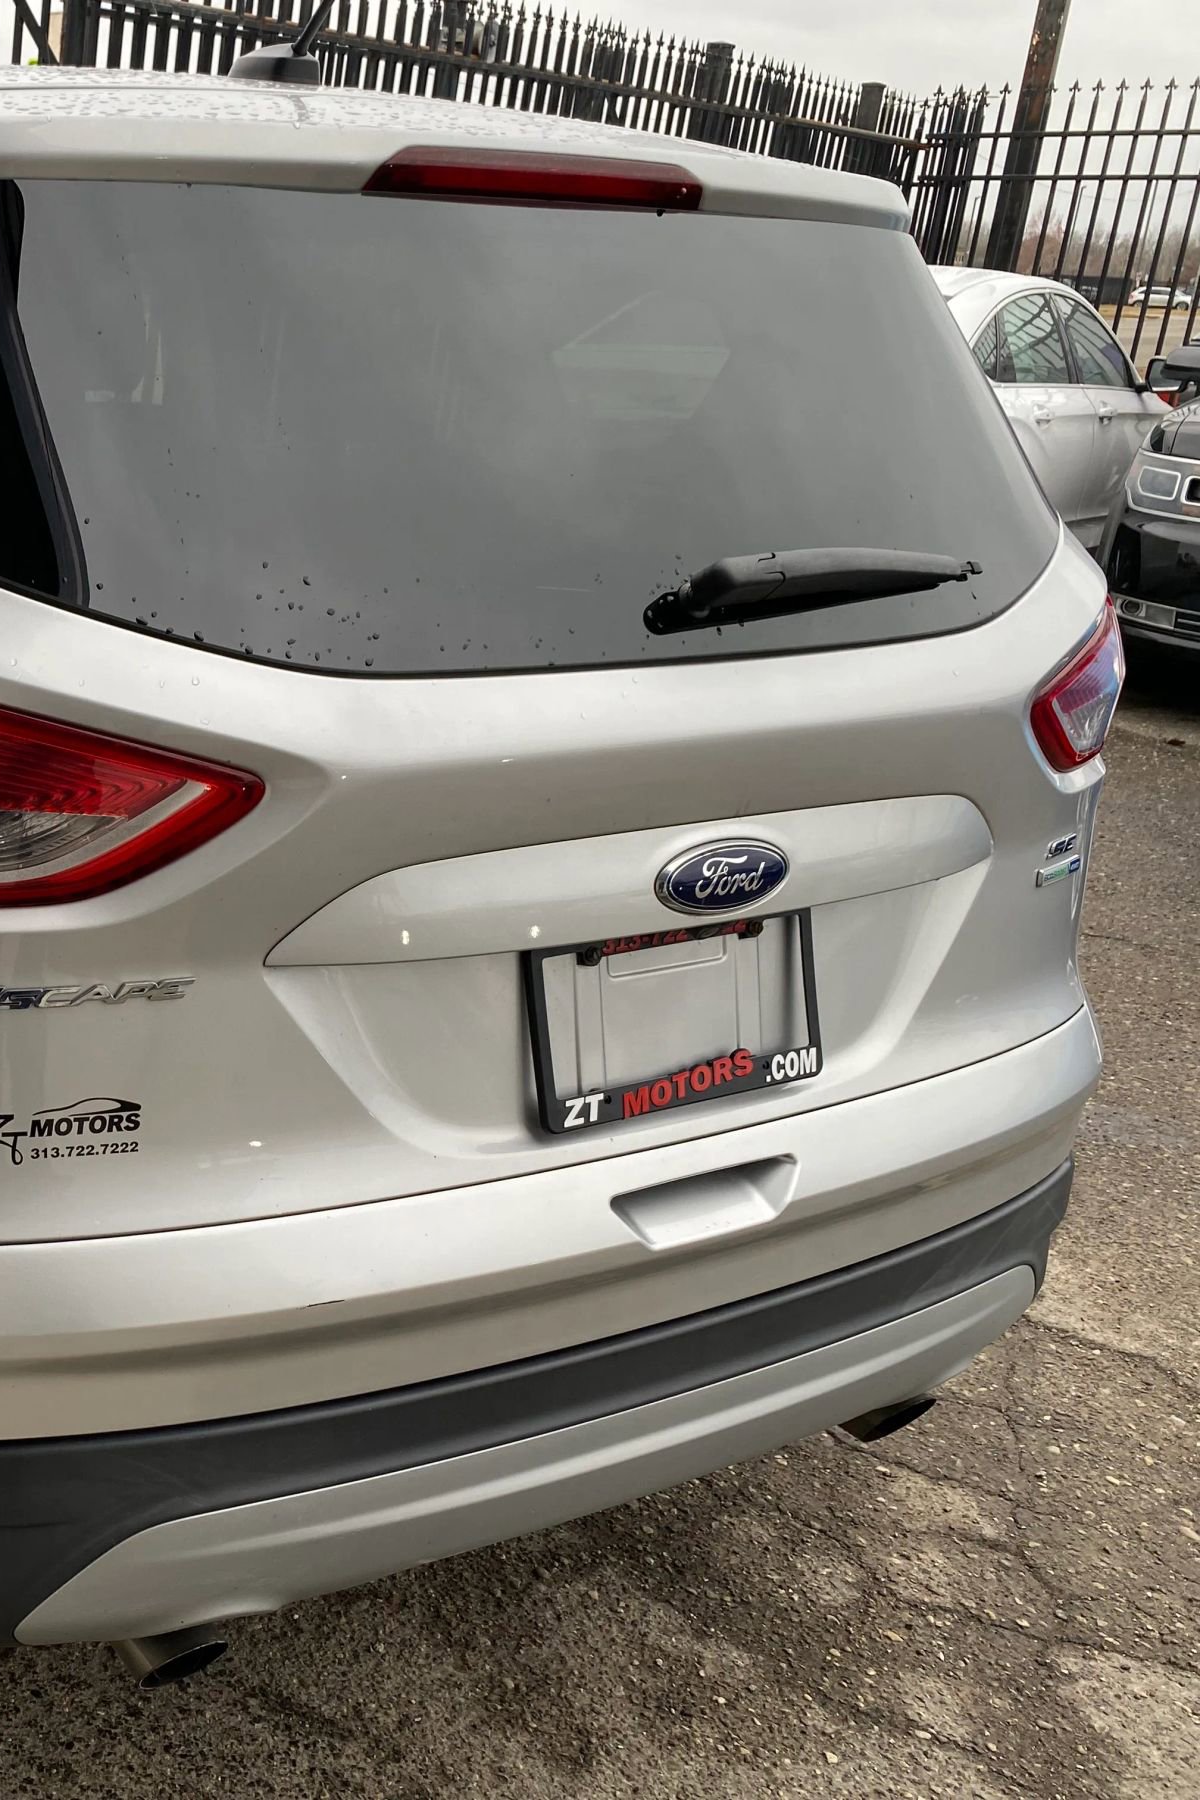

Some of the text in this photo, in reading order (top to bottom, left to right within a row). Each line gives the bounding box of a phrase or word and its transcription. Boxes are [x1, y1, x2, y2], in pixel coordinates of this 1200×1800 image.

[695, 855, 766, 899] Ford
[563, 1046, 818, 1128] ZT MOTORS .COM
[29, 1113, 142, 1138] MOTORS
[30, 1141, 140, 1161] 313.722.7222
